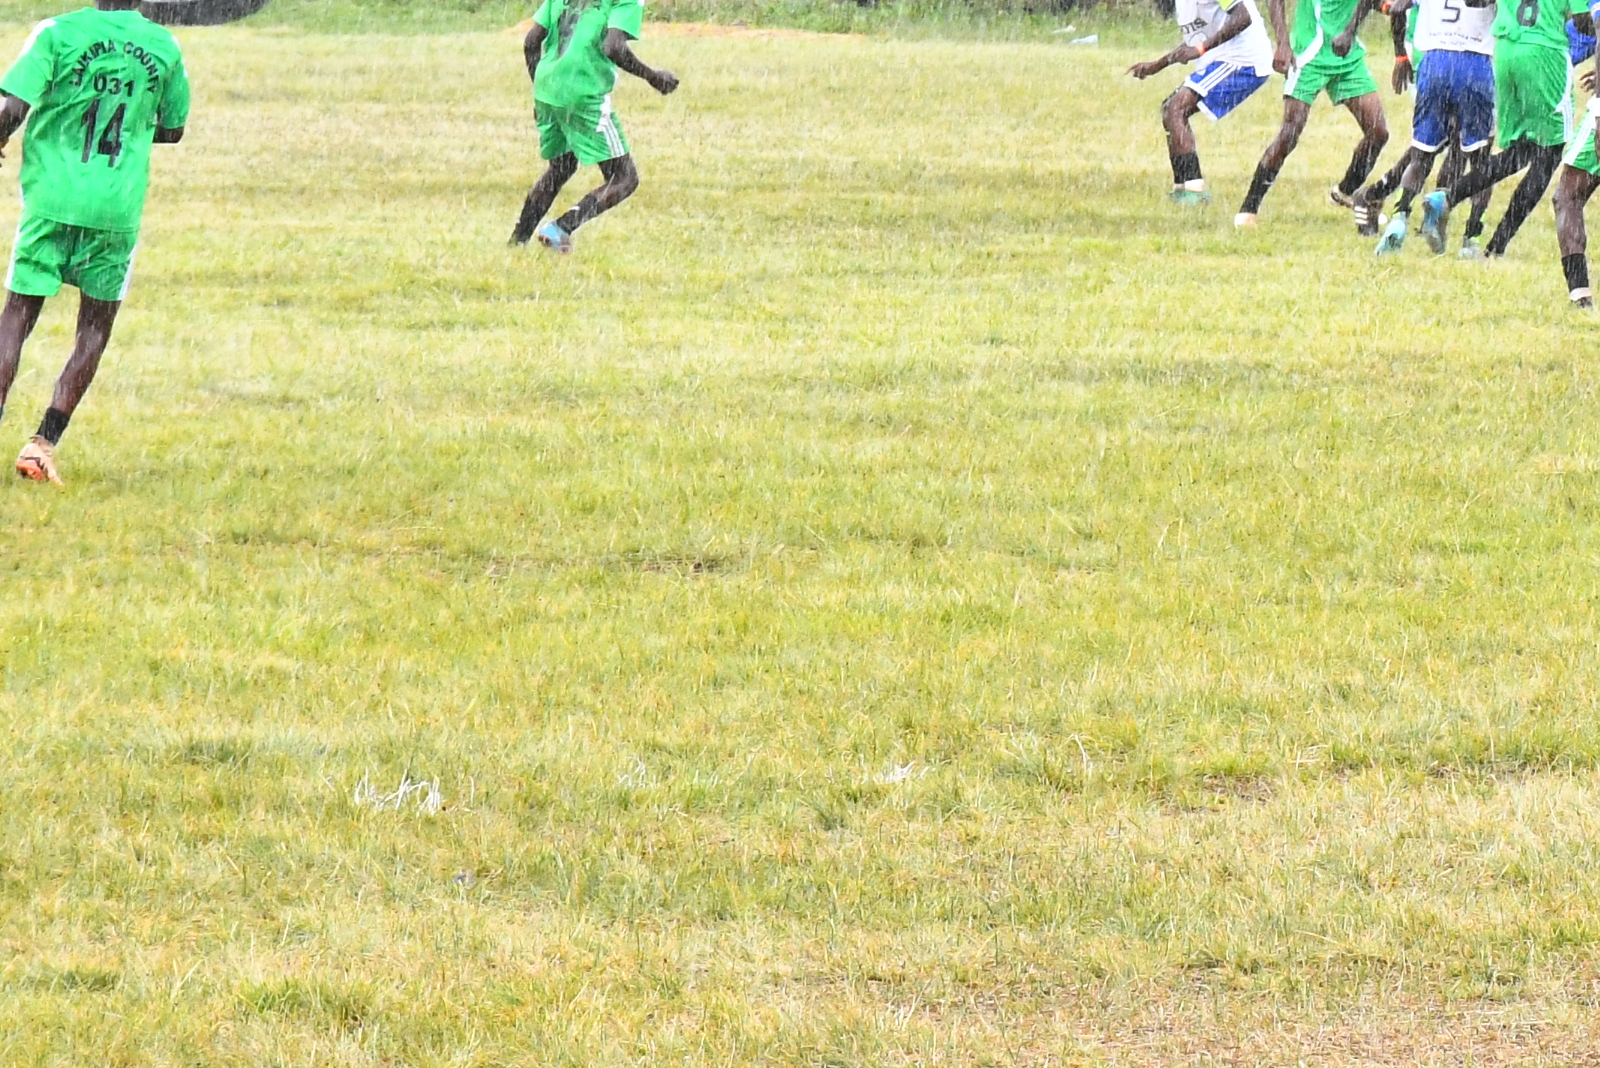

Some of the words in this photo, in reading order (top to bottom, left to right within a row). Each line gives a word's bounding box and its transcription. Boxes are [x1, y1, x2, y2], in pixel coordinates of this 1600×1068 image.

[93, 73, 135, 97] 031
[123, 41, 160, 94] COUNTY
[80, 98, 127, 168] 14
